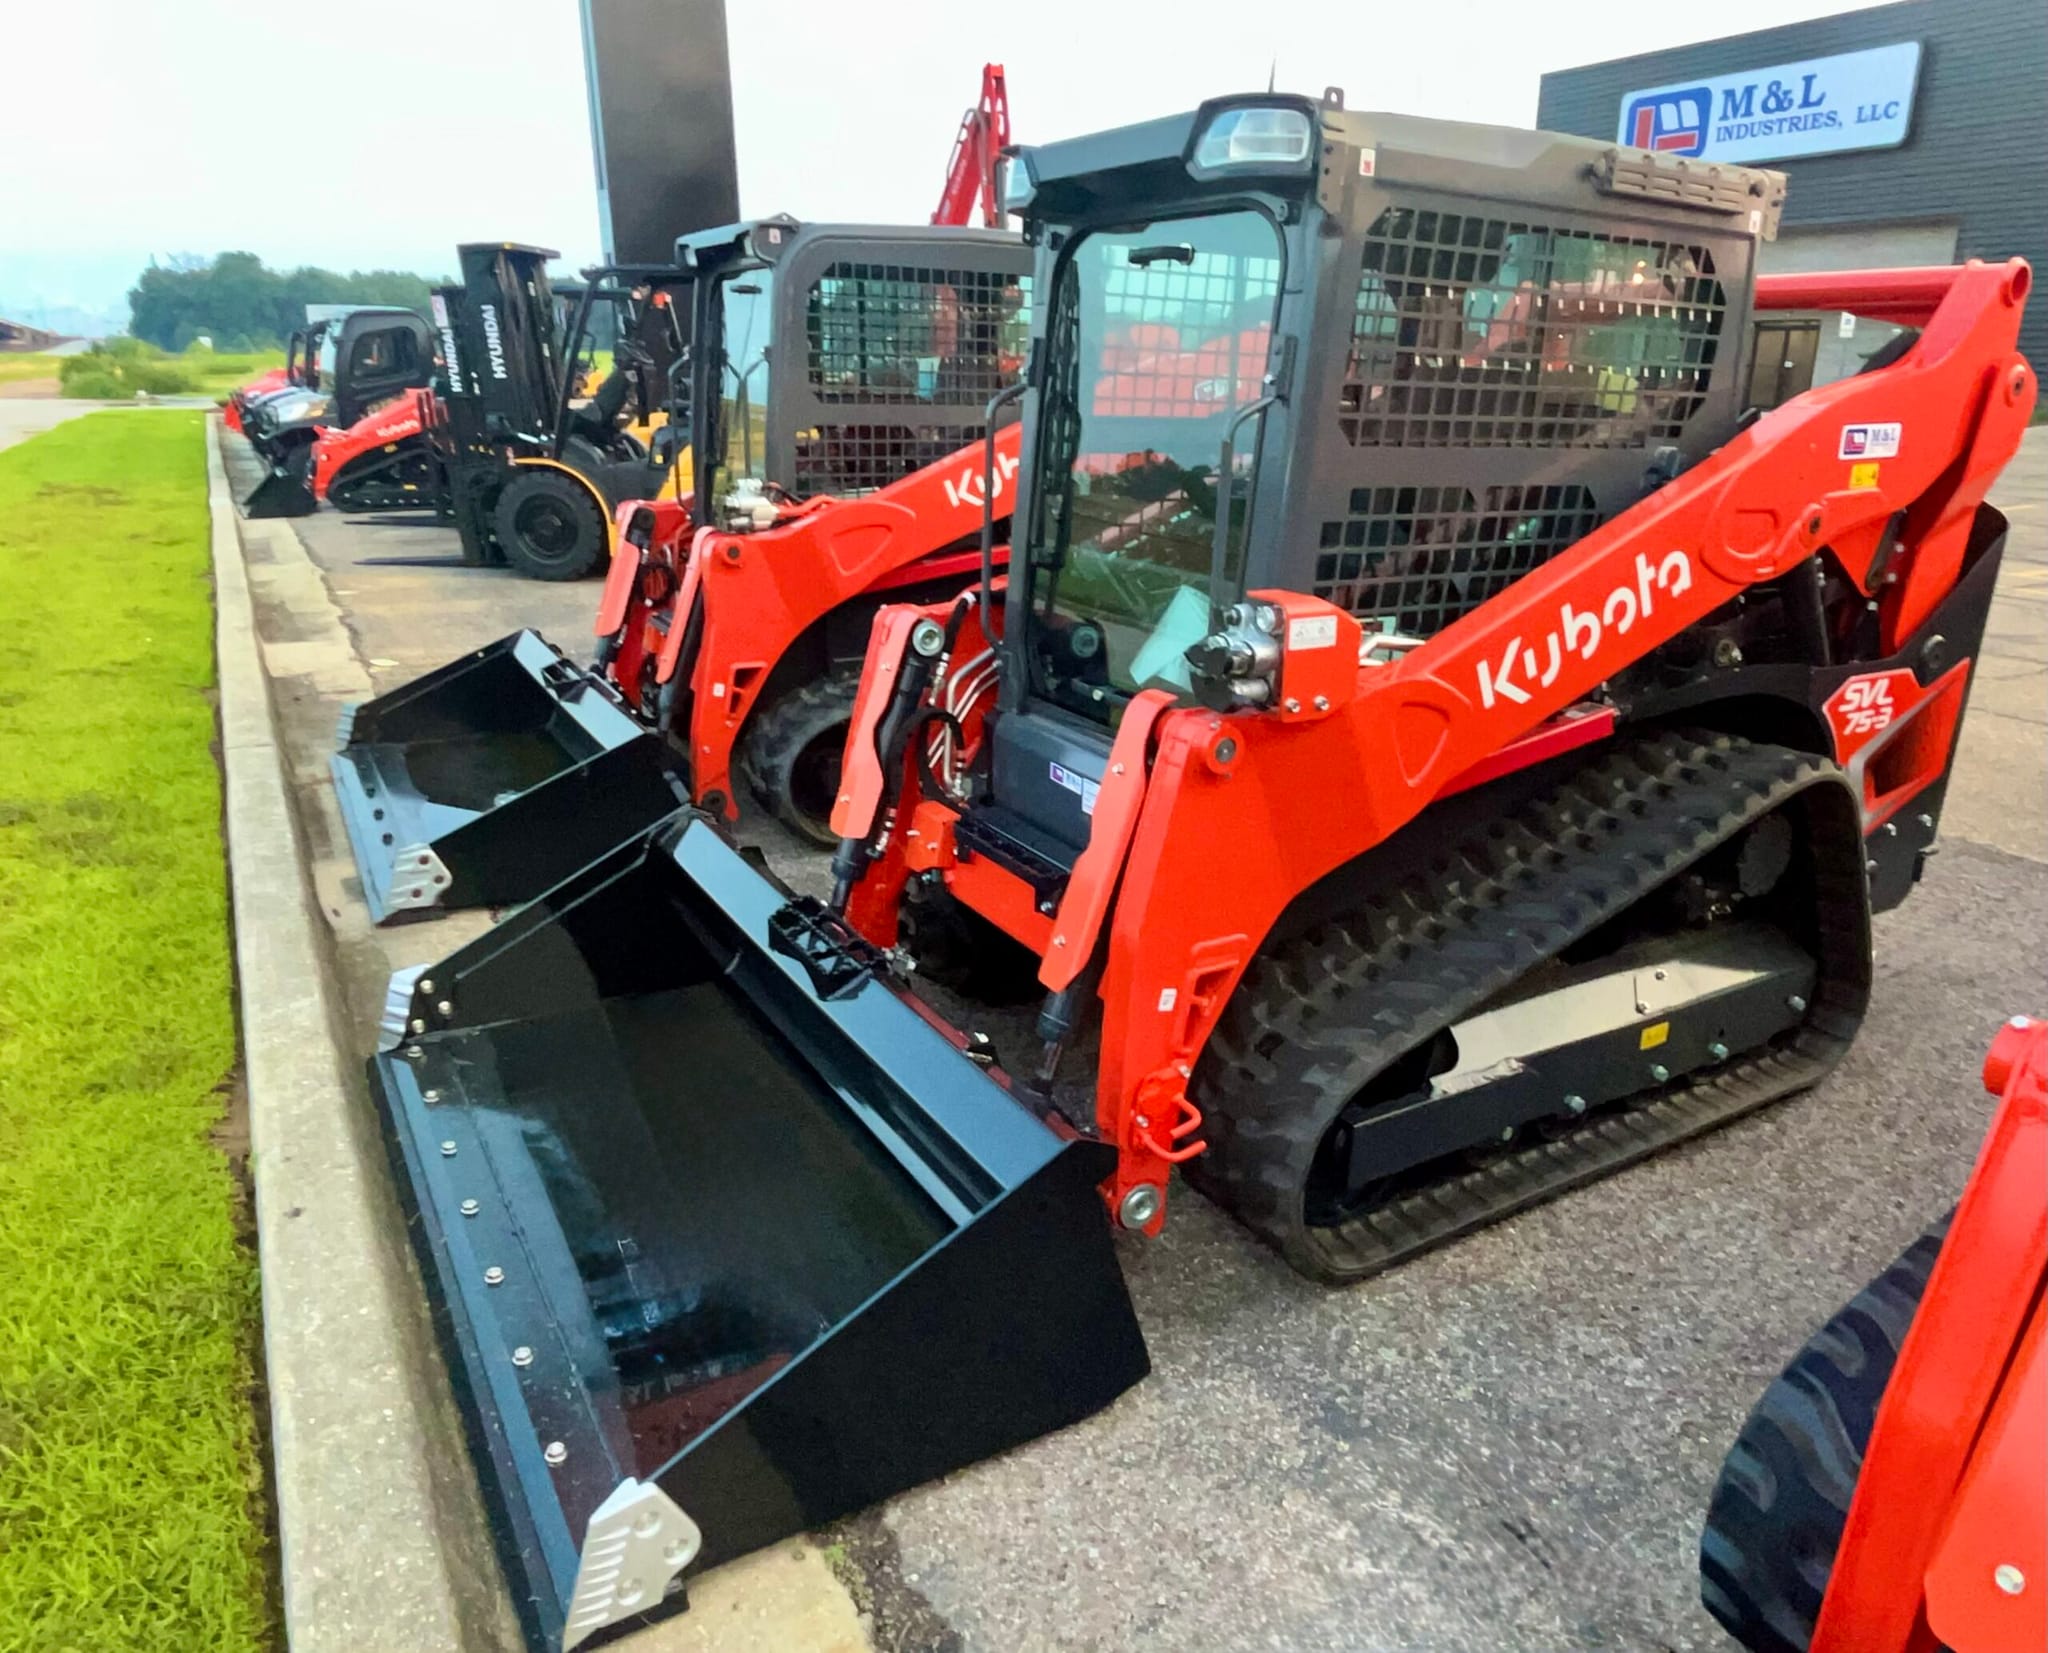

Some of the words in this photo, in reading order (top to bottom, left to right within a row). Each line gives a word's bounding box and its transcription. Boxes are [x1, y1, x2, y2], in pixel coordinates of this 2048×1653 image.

[1715, 110, 1843, 143] INDUSTRIES,
[1855, 101, 1899, 124] LLC
[440, 328, 463, 393] HYUNDAI
[480, 304, 508, 379] HYUNDAI
[1476, 550, 1692, 710] Kubota
[1838, 678, 1895, 712] SVL
